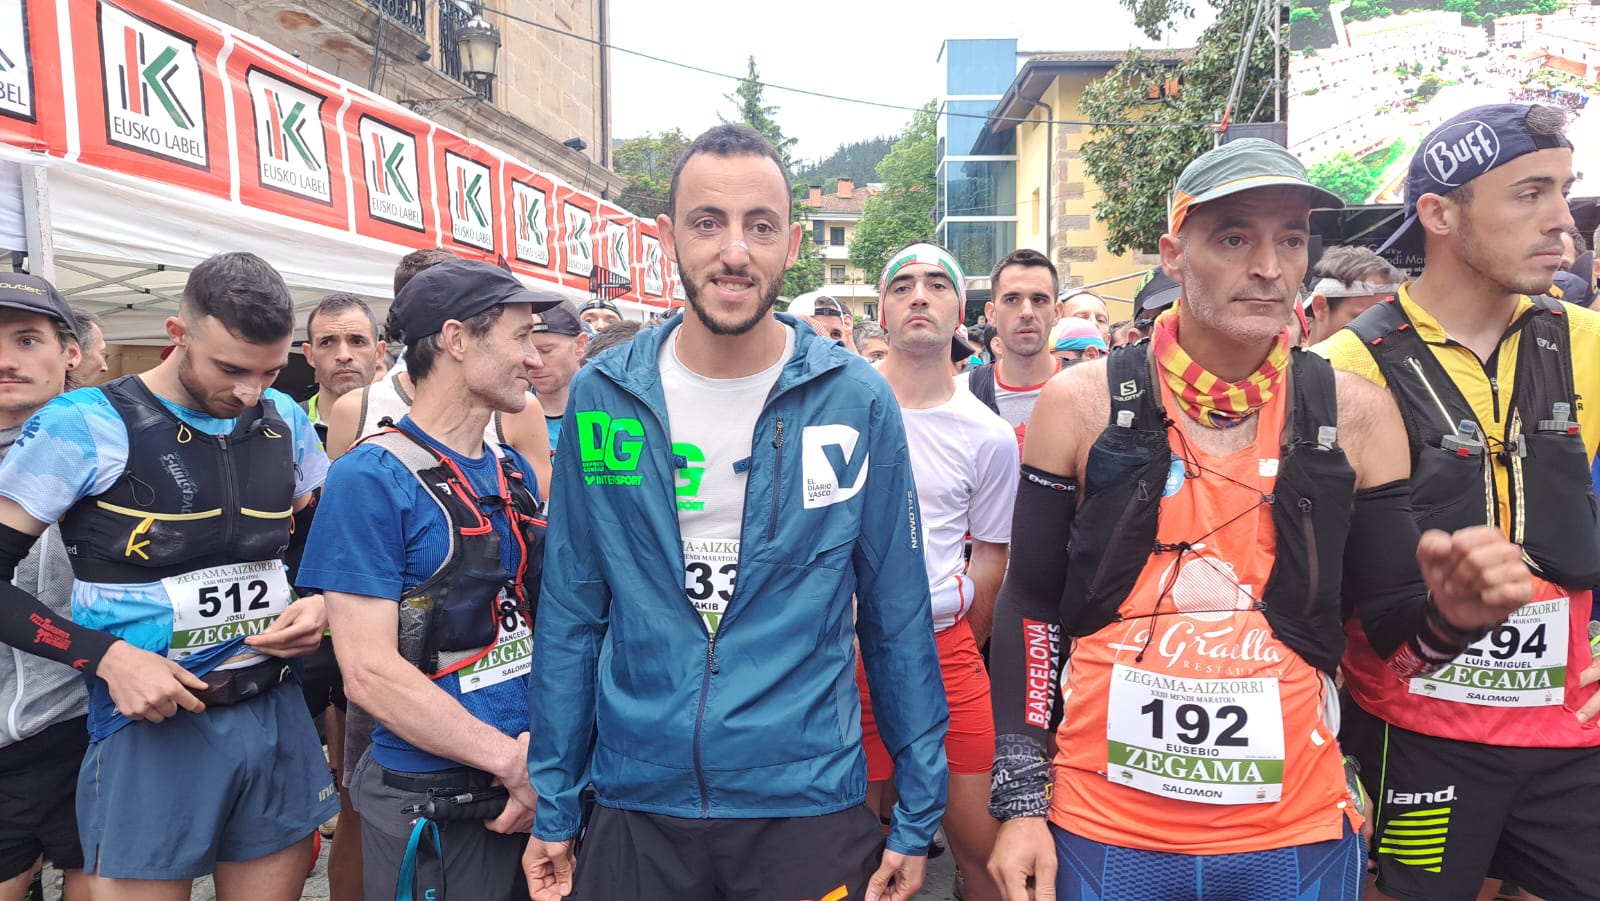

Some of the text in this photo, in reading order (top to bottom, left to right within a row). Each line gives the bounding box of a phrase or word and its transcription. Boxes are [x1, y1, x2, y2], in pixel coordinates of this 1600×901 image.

[114, 116, 204, 159] EUSKO LABEL
[263, 163, 329, 196] EUSKO LABEL
[372, 197, 421, 224] EUSKO LABEL
[454, 224, 493, 246] EUSKO LABEL
[596, 475, 643, 486] INTERSPORT
[807, 483, 832, 491] DIARIO
[808, 490, 831, 498] VASCO
[908, 490, 918, 549] SALOMON
[177, 561, 277, 584] ZEGAMA-AIZKORRI
[199, 579, 270, 618] 512
[225, 614, 246, 623] JOSU
[187, 616, 275, 647] ZEGAM
[1027, 624, 1049, 724] BARCELONA
[1465, 657, 1491, 667] LUIS
[1494, 661, 1532, 669] MIGUEL
[1124, 670, 1264, 694] ZEGAMA-AIZKORRI
[1151, 690, 1236, 703] XXIII MENDI MARATOIA
[1466, 692, 1519, 703] SALOMON
[1141, 698, 1249, 747] 192
[1166, 743, 1220, 756] EUSEBIO
[1125, 747, 1264, 783] ZEGAMA
[1162, 783, 1223, 798] SALOMON
